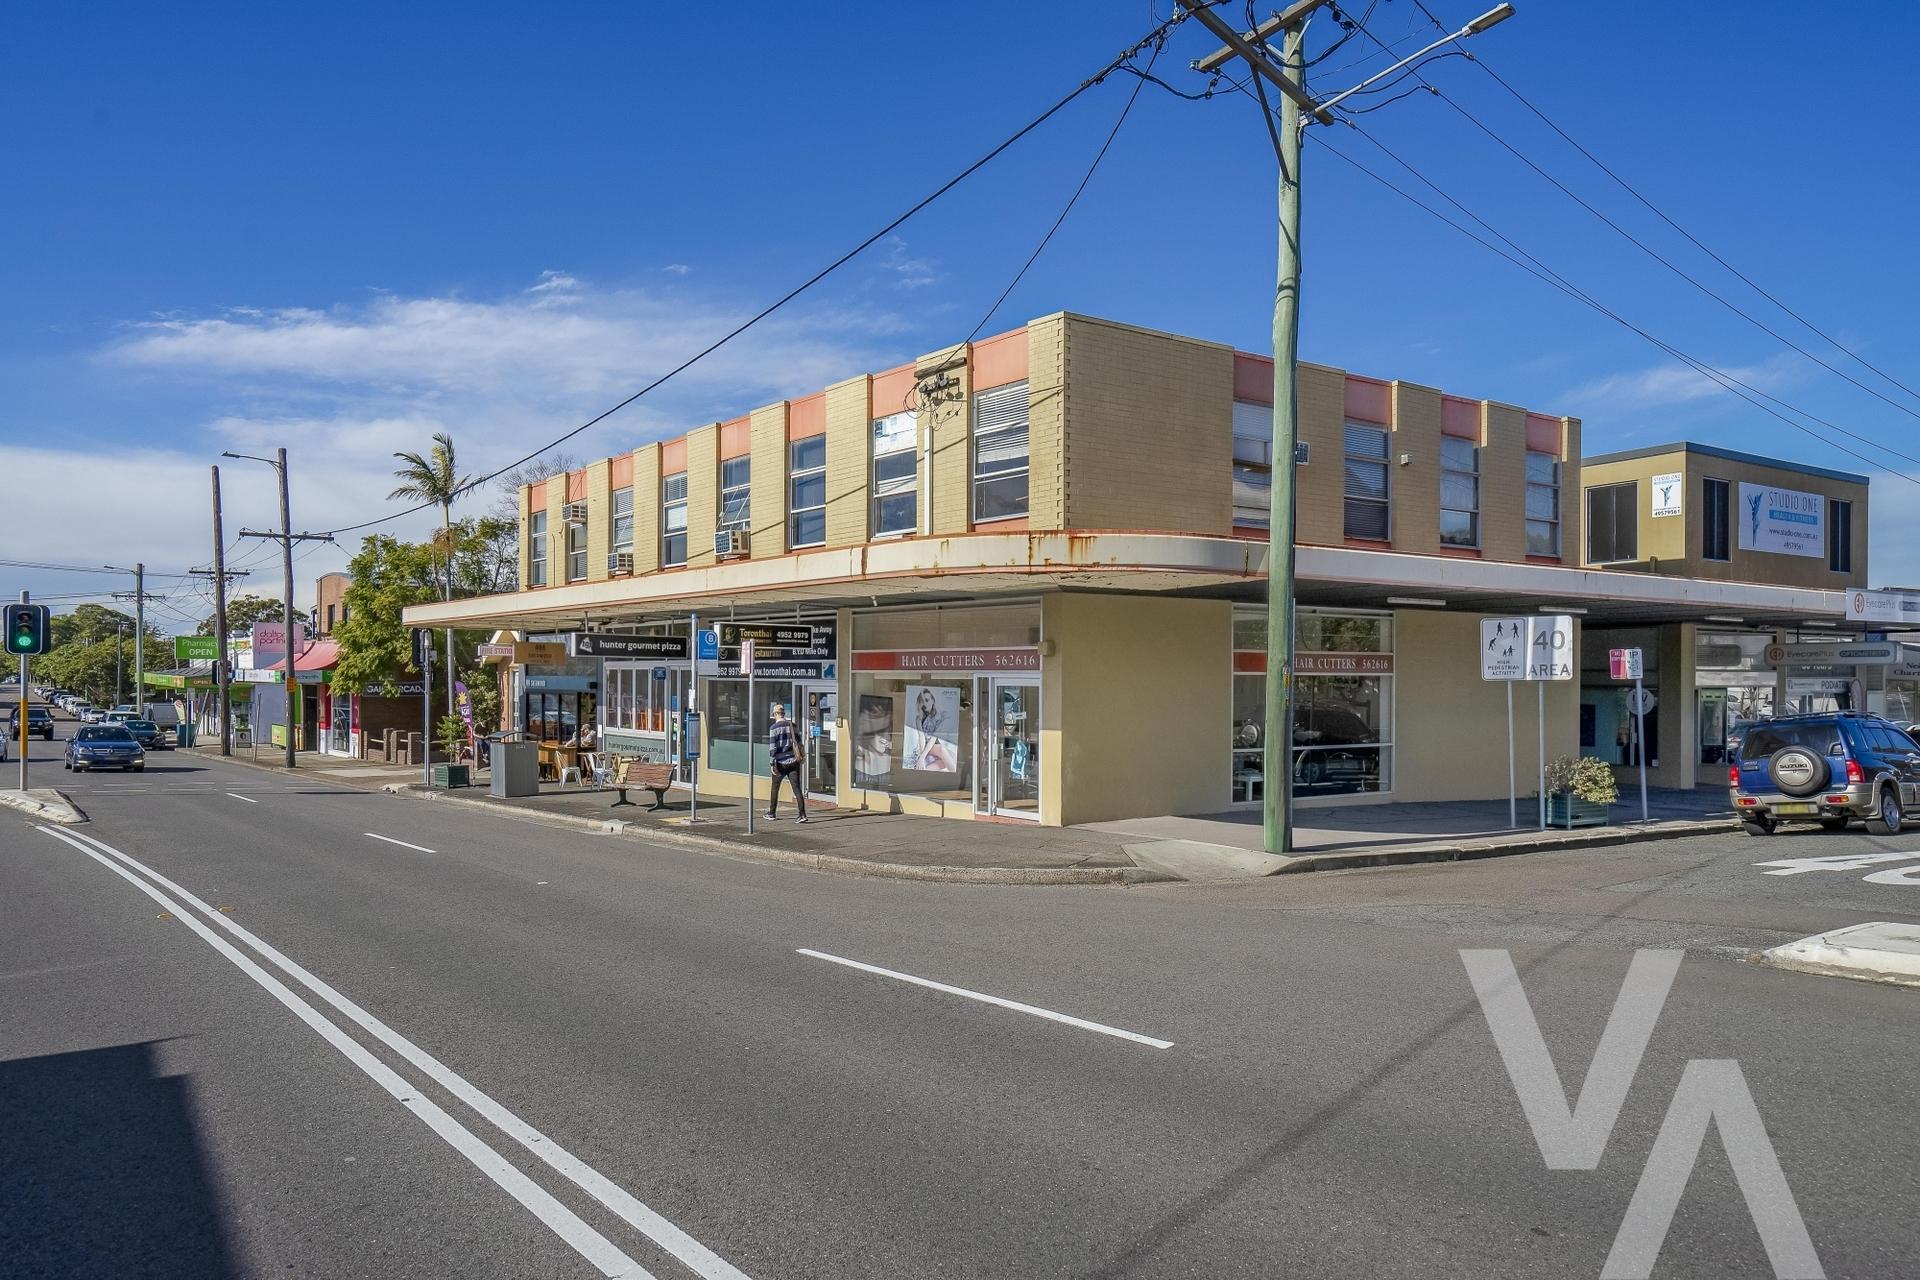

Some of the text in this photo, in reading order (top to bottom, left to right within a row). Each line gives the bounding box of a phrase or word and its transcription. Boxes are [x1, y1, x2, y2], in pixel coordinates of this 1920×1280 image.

[1769, 491, 1818, 512] STUDIO ONE
[740, 628, 772, 638] Toronthai
[794, 631, 809, 639] 9979
[600, 640, 681, 651] hunter gourmet pizza
[1533, 630, 1566, 651] 40
[189, 645, 213, 656] OPEN
[902, 654, 1036, 666] HAIR CUTTERS 562616
[1318, 658, 1357, 669] CUTTERS
[1362, 659, 1389, 669] 562616
[1528, 663, 1571, 676] AREA
